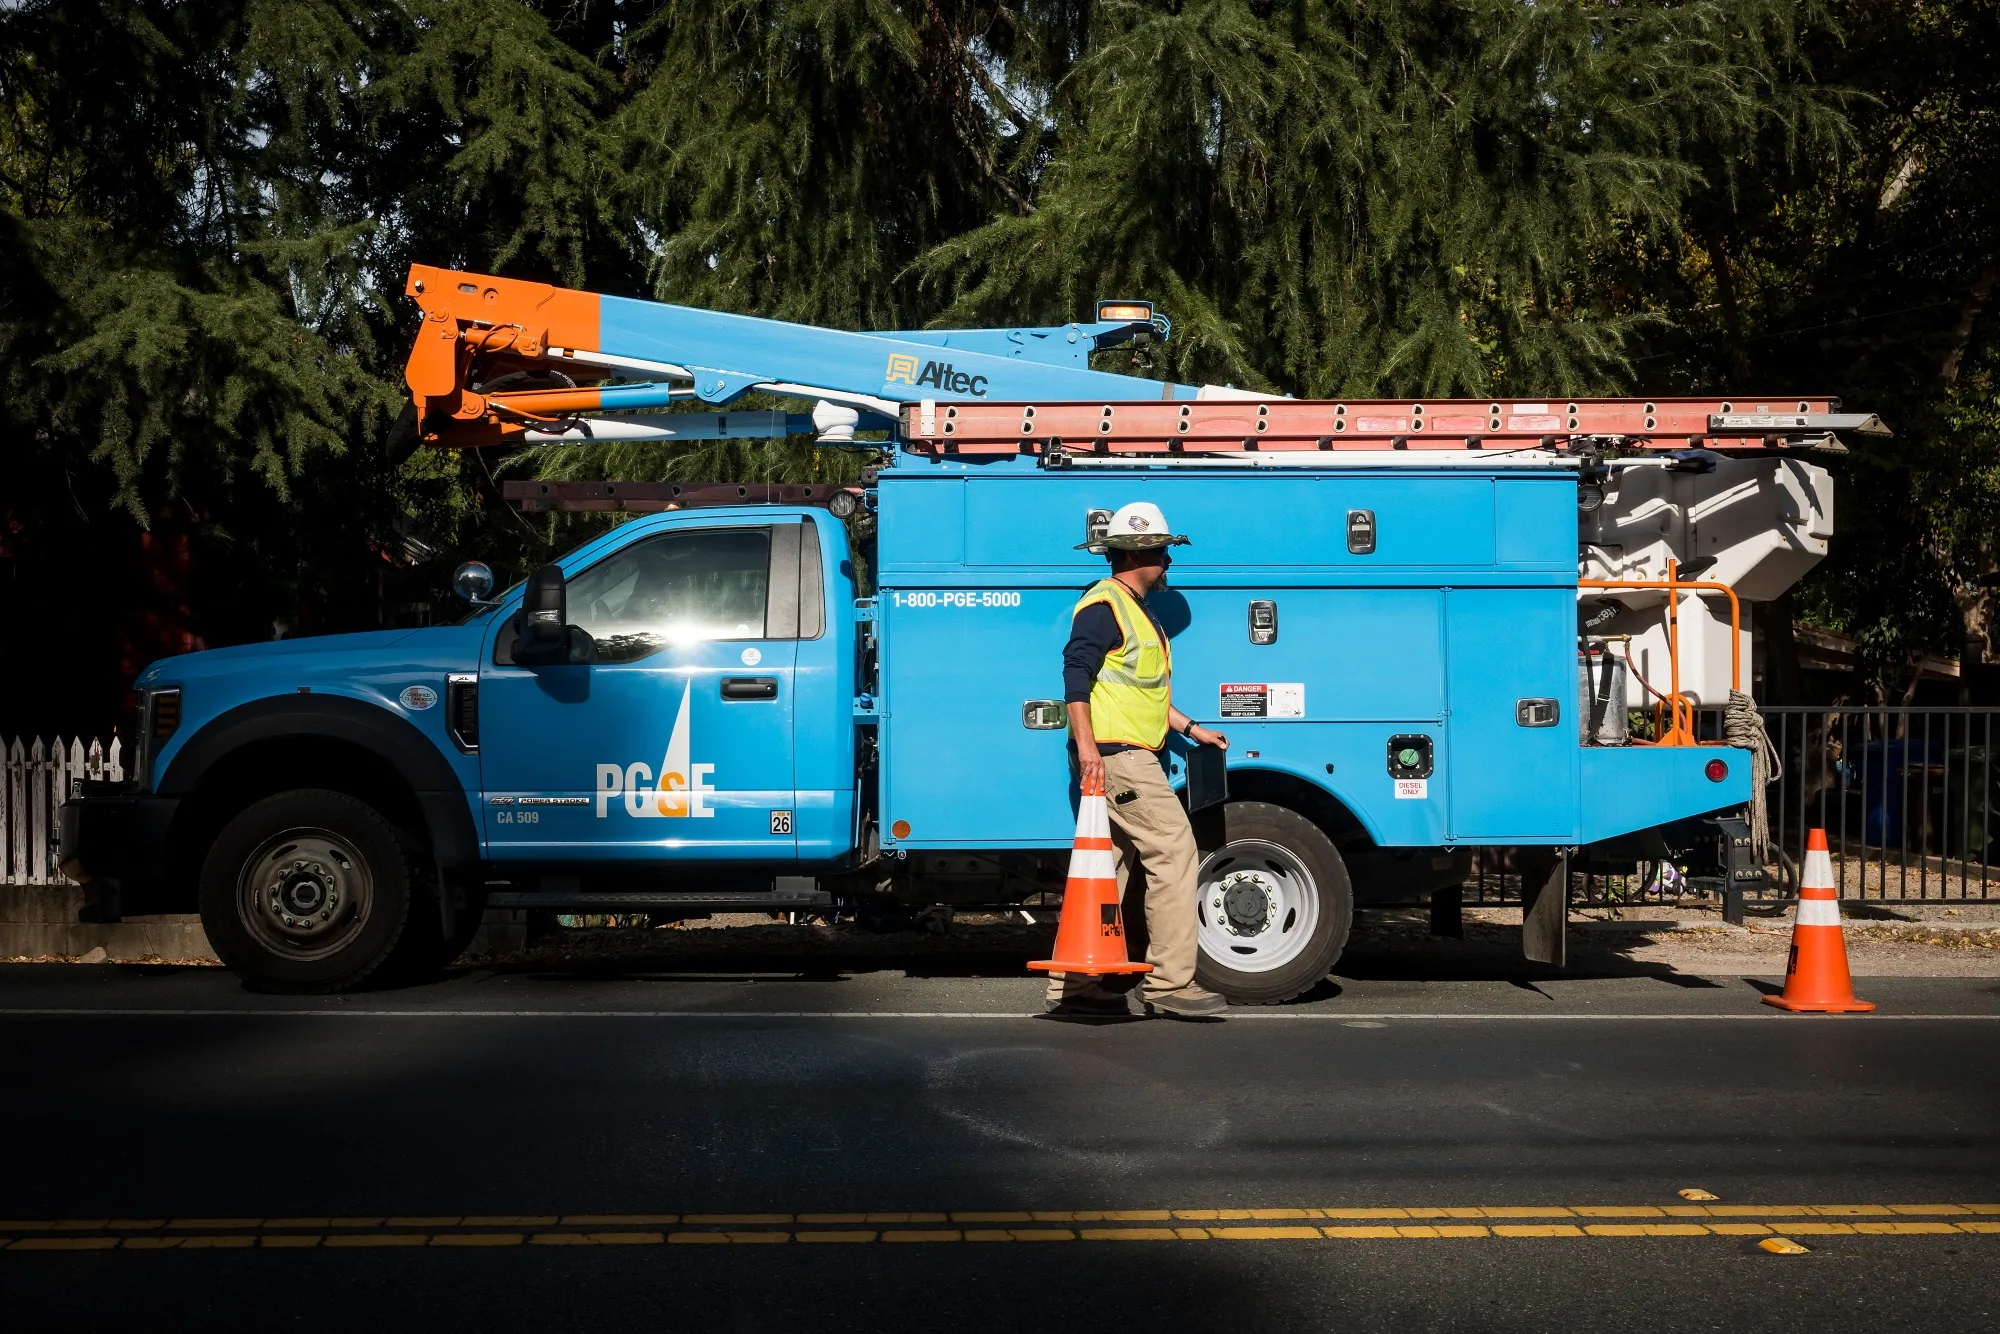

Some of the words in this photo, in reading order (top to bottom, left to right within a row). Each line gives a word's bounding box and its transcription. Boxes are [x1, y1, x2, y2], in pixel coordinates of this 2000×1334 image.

[916, 360, 988, 397] Altec
[893, 591, 1021, 608] 1-800-PGE-5000
[596, 761, 715, 818] PG&E
[497, 812, 514, 823] CA
[517, 812, 539, 823] 509
[773, 816, 790, 832] 26
